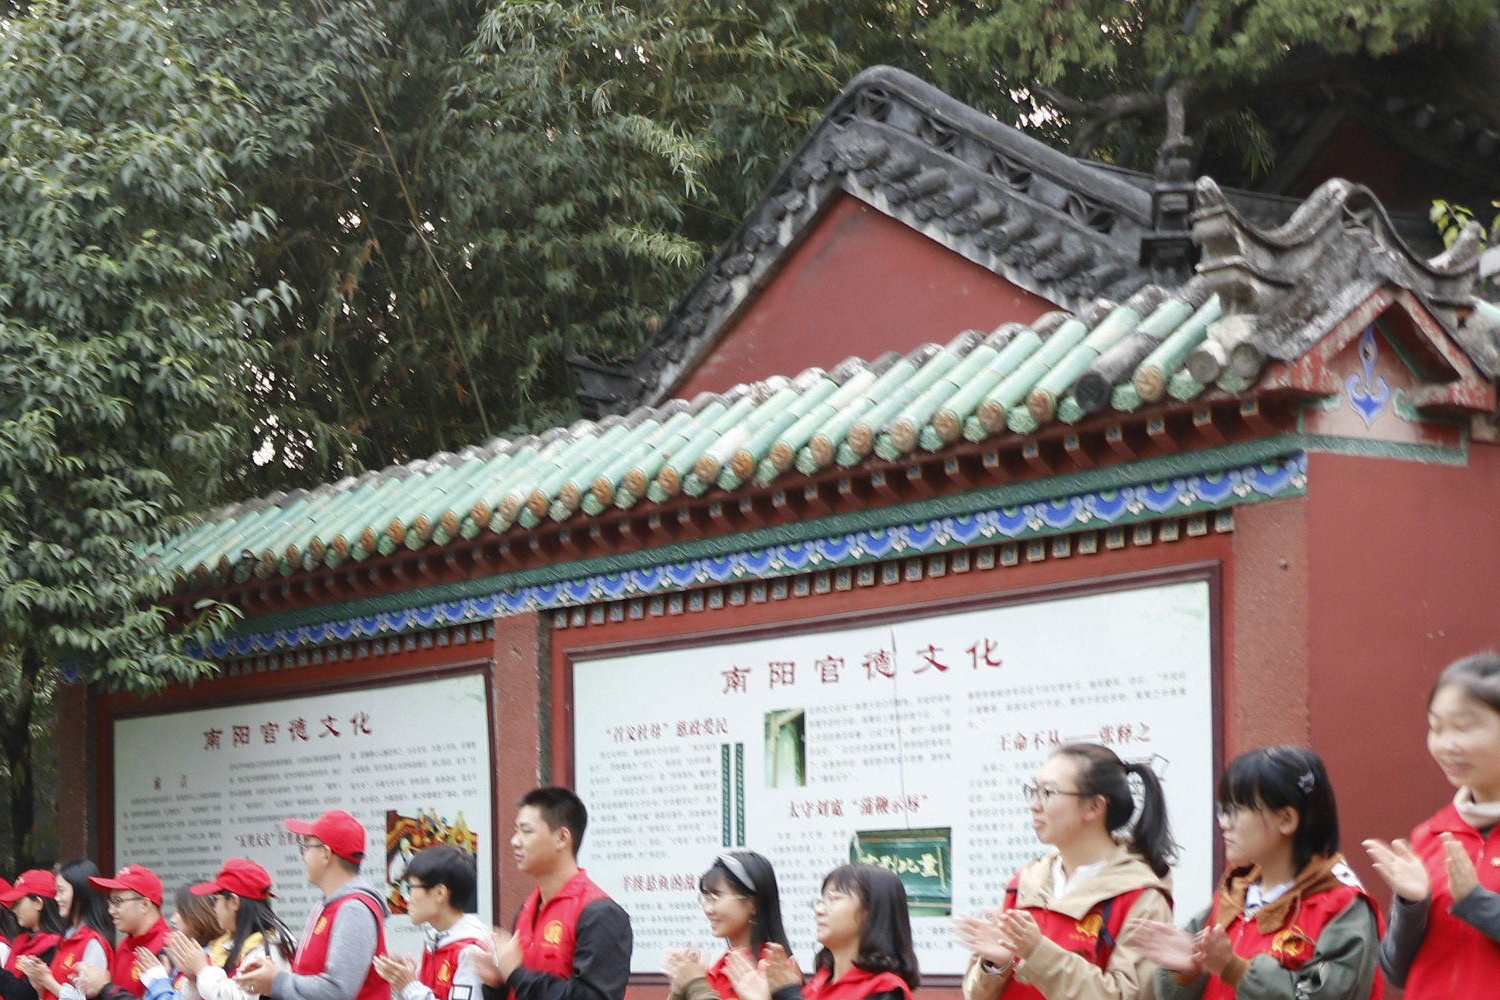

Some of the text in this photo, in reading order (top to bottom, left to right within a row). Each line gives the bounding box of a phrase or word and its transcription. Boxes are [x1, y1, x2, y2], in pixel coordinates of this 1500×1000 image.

[720, 638, 1003, 694] 南阳官德文化
[203, 711, 372, 751] 南阳官德文化
